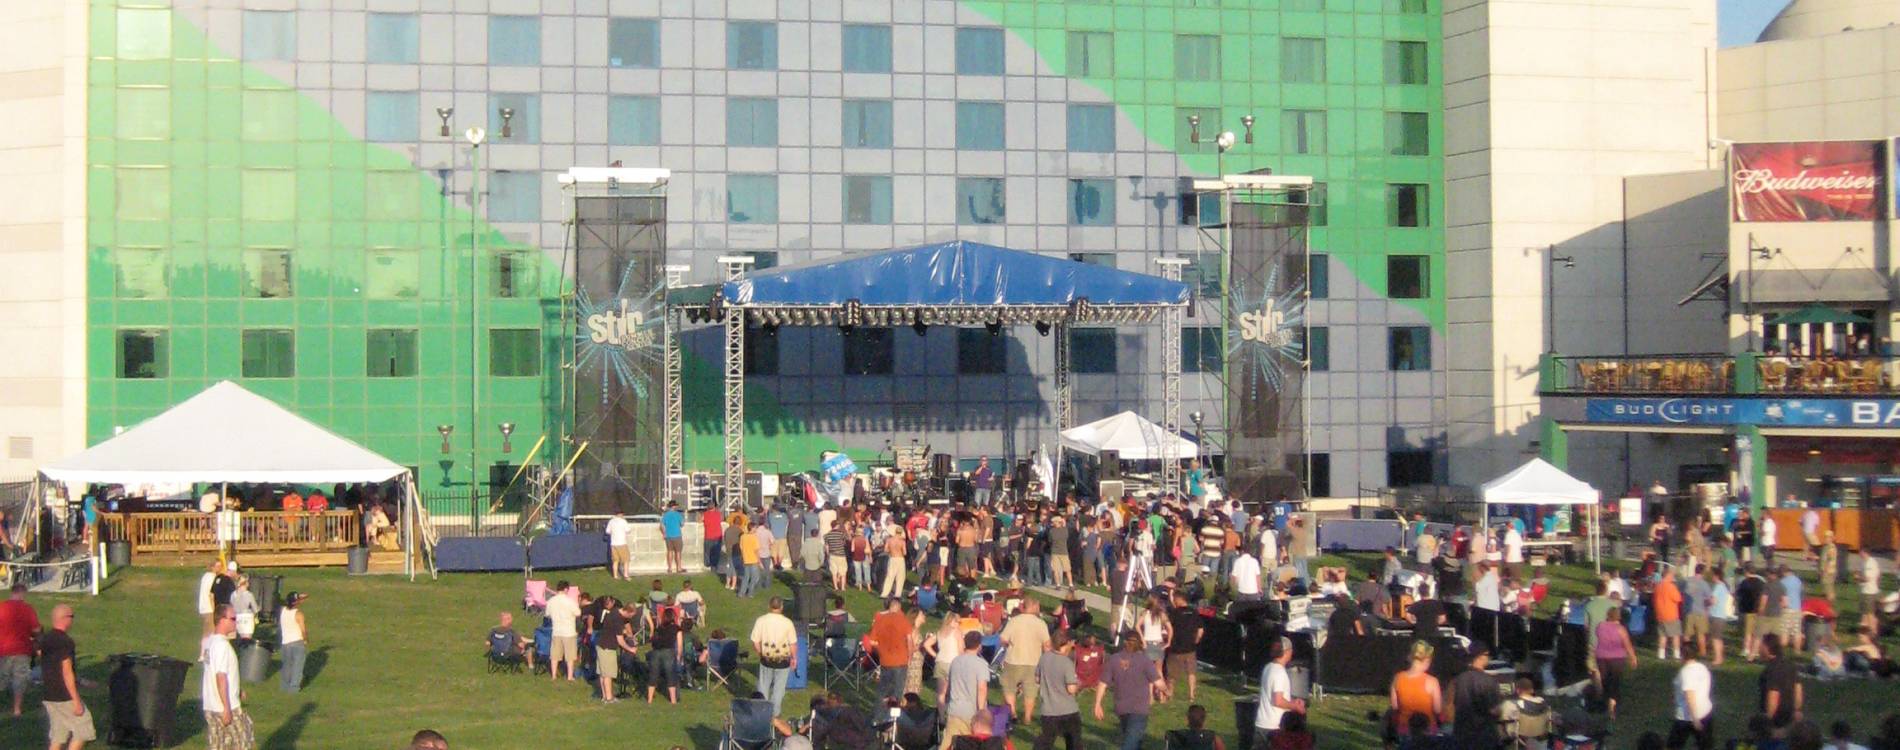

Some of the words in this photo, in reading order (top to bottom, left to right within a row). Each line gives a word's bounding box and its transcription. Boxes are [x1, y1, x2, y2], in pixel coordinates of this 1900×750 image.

[1735, 168, 1879, 193] Budweiser
[1615, 404, 1655, 415] BUD
[1669, 404, 1735, 415] LIGHT
